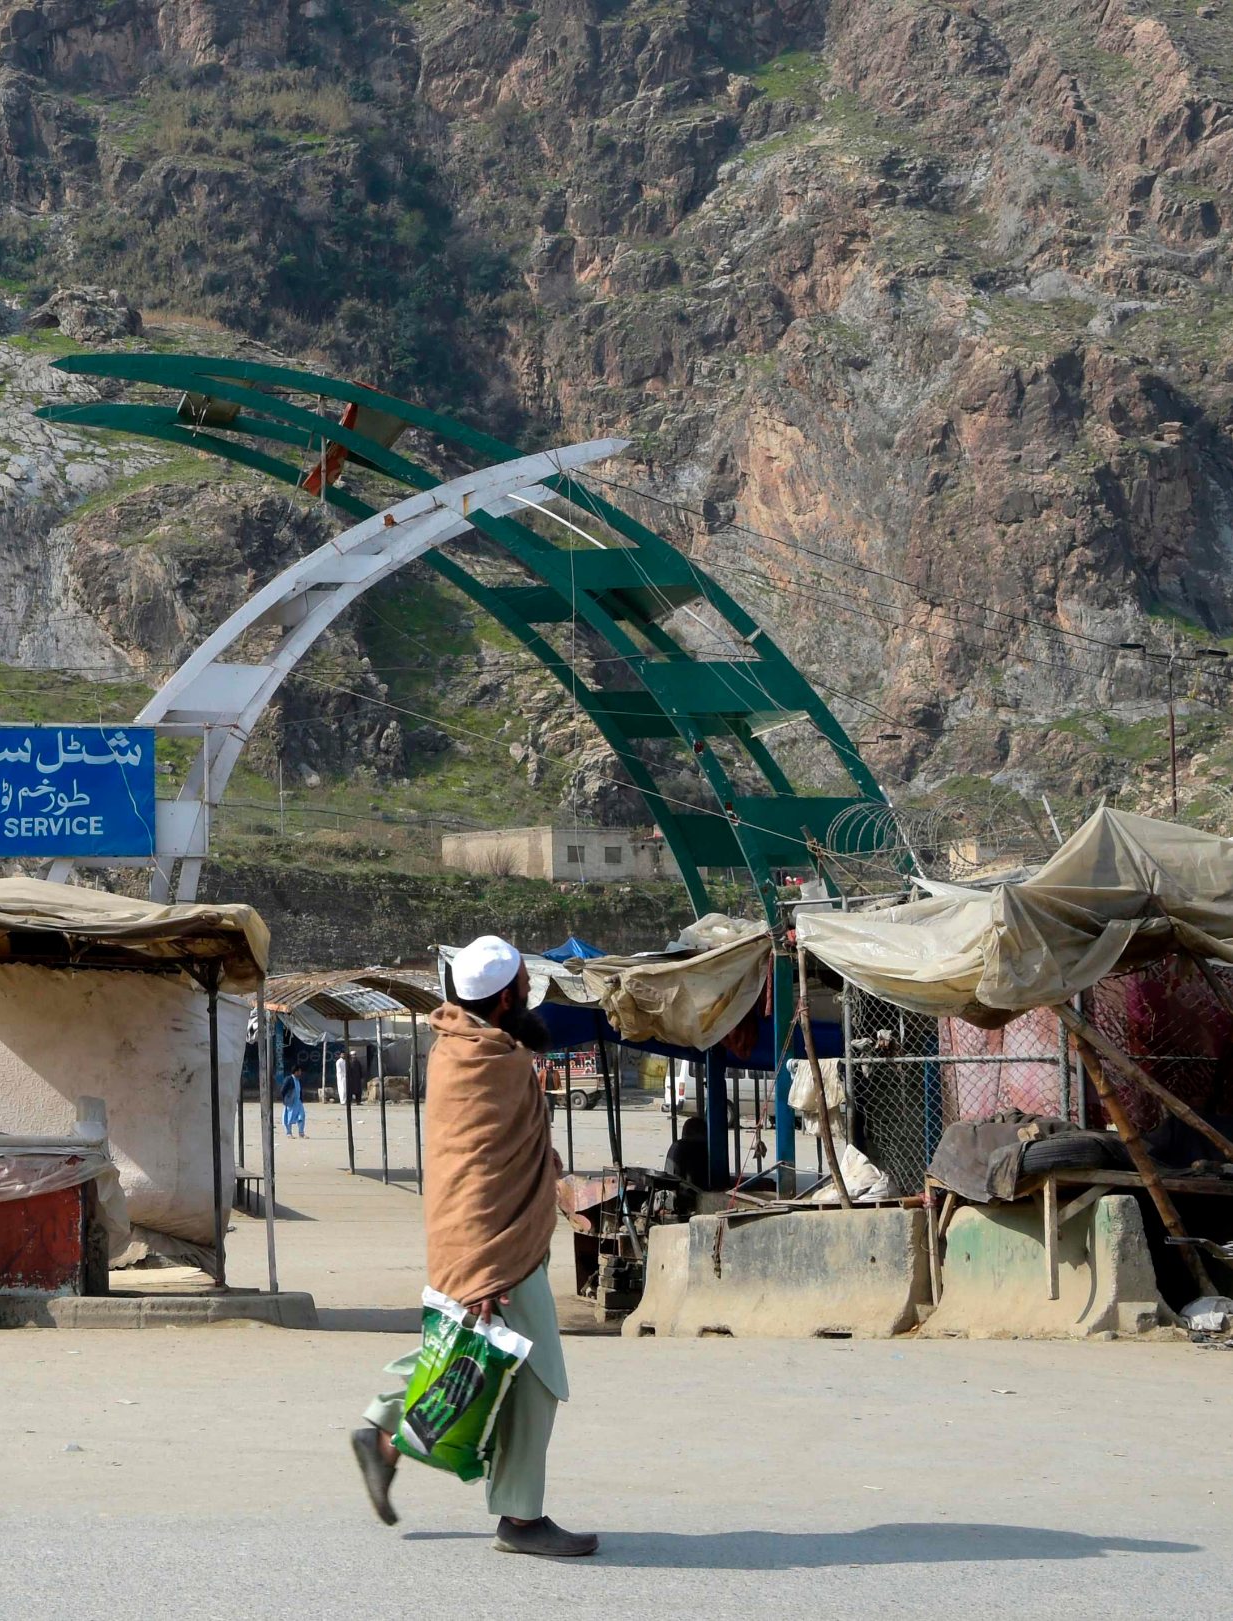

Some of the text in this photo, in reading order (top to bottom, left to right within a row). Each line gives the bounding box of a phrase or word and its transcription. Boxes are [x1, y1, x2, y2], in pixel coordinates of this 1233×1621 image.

[36, 730, 142, 774] شٹل
[18, 778, 91, 816] طورخم
[3, 816, 104, 838] SERVICE
